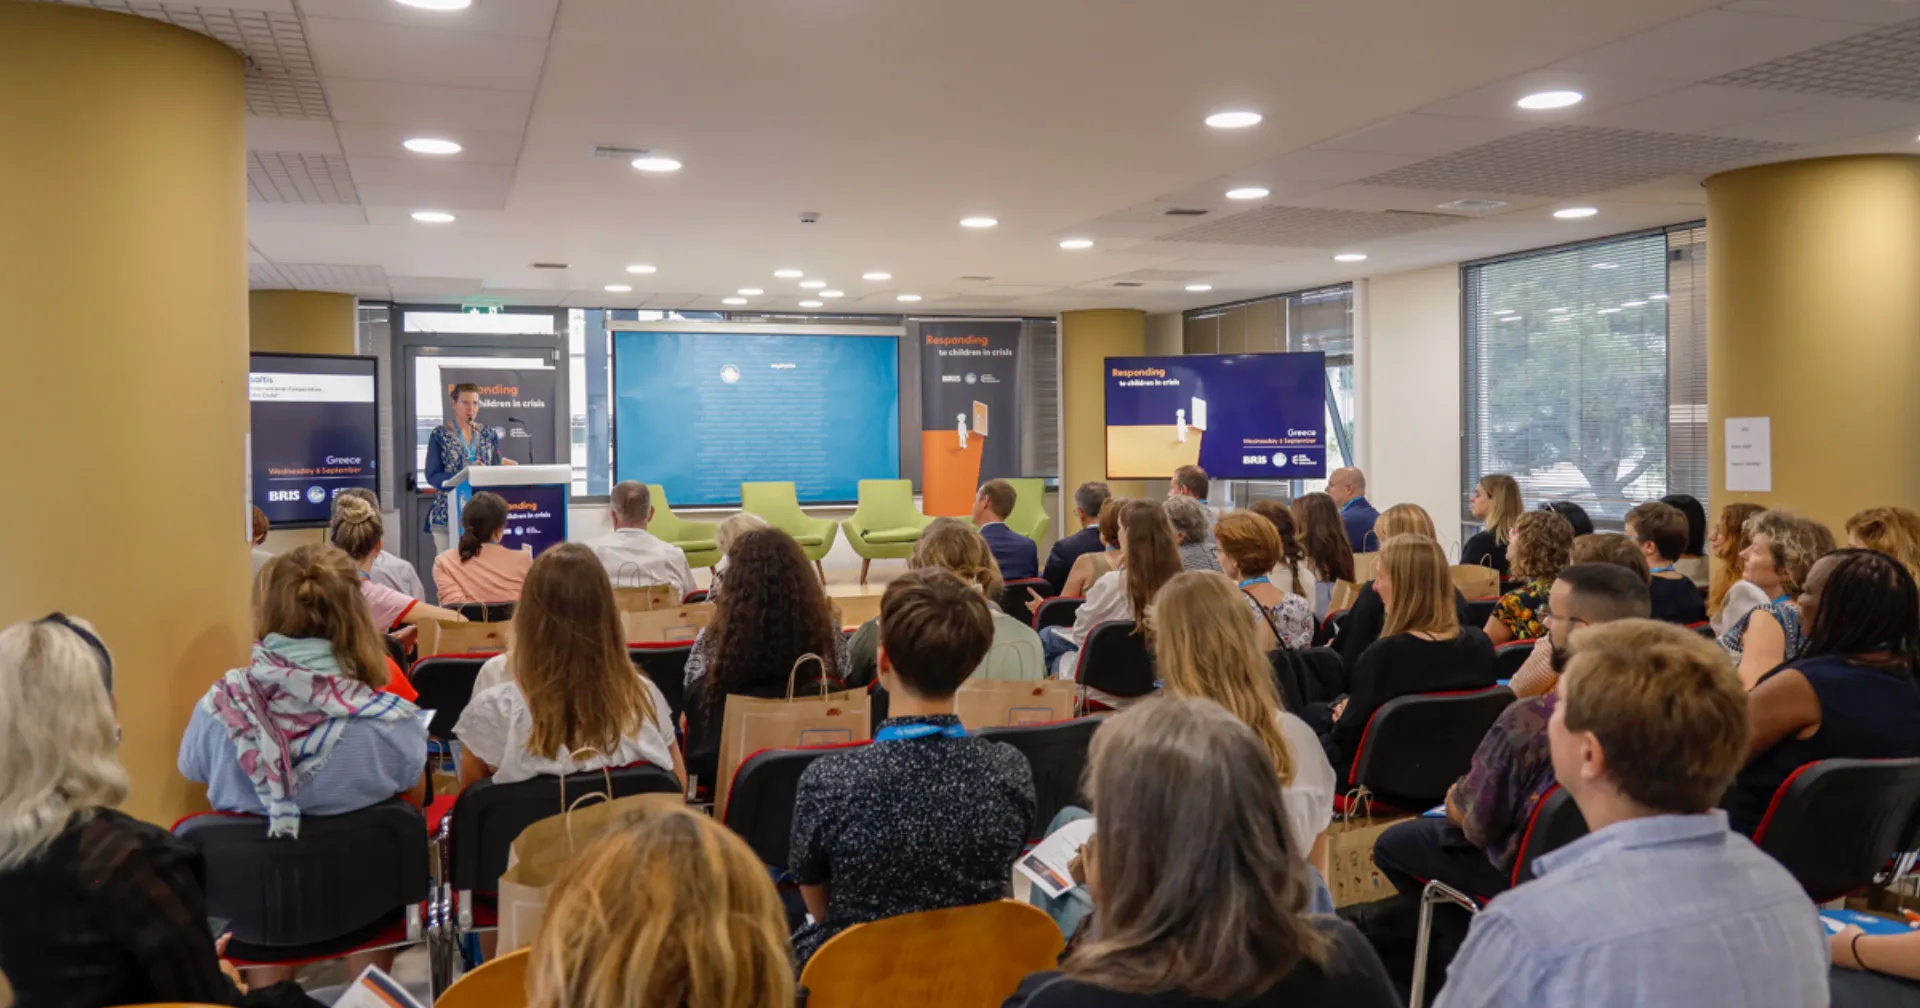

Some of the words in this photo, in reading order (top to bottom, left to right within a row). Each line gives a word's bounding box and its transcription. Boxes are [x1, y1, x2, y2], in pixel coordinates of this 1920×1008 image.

[926, 335, 988, 346] Responding
[949, 347, 981, 356] children
[992, 348, 1012, 356] crisis
[1112, 368, 1165, 378] Responding
[1127, 379, 1154, 387] children
[1162, 379, 1180, 387] crisis
[478, 398, 511, 408] hildren
[522, 398, 546, 408] crisis
[1287, 428, 1316, 436] Greece
[326, 455, 361, 464] Greece
[1243, 455, 1268, 465] BRIS
[268, 467, 314, 475] Wednesday
[322, 466, 361, 475] September
[269, 490, 300, 501] BRIS
[507, 501, 538, 511] onding
[534, 511, 551, 519] crisis
